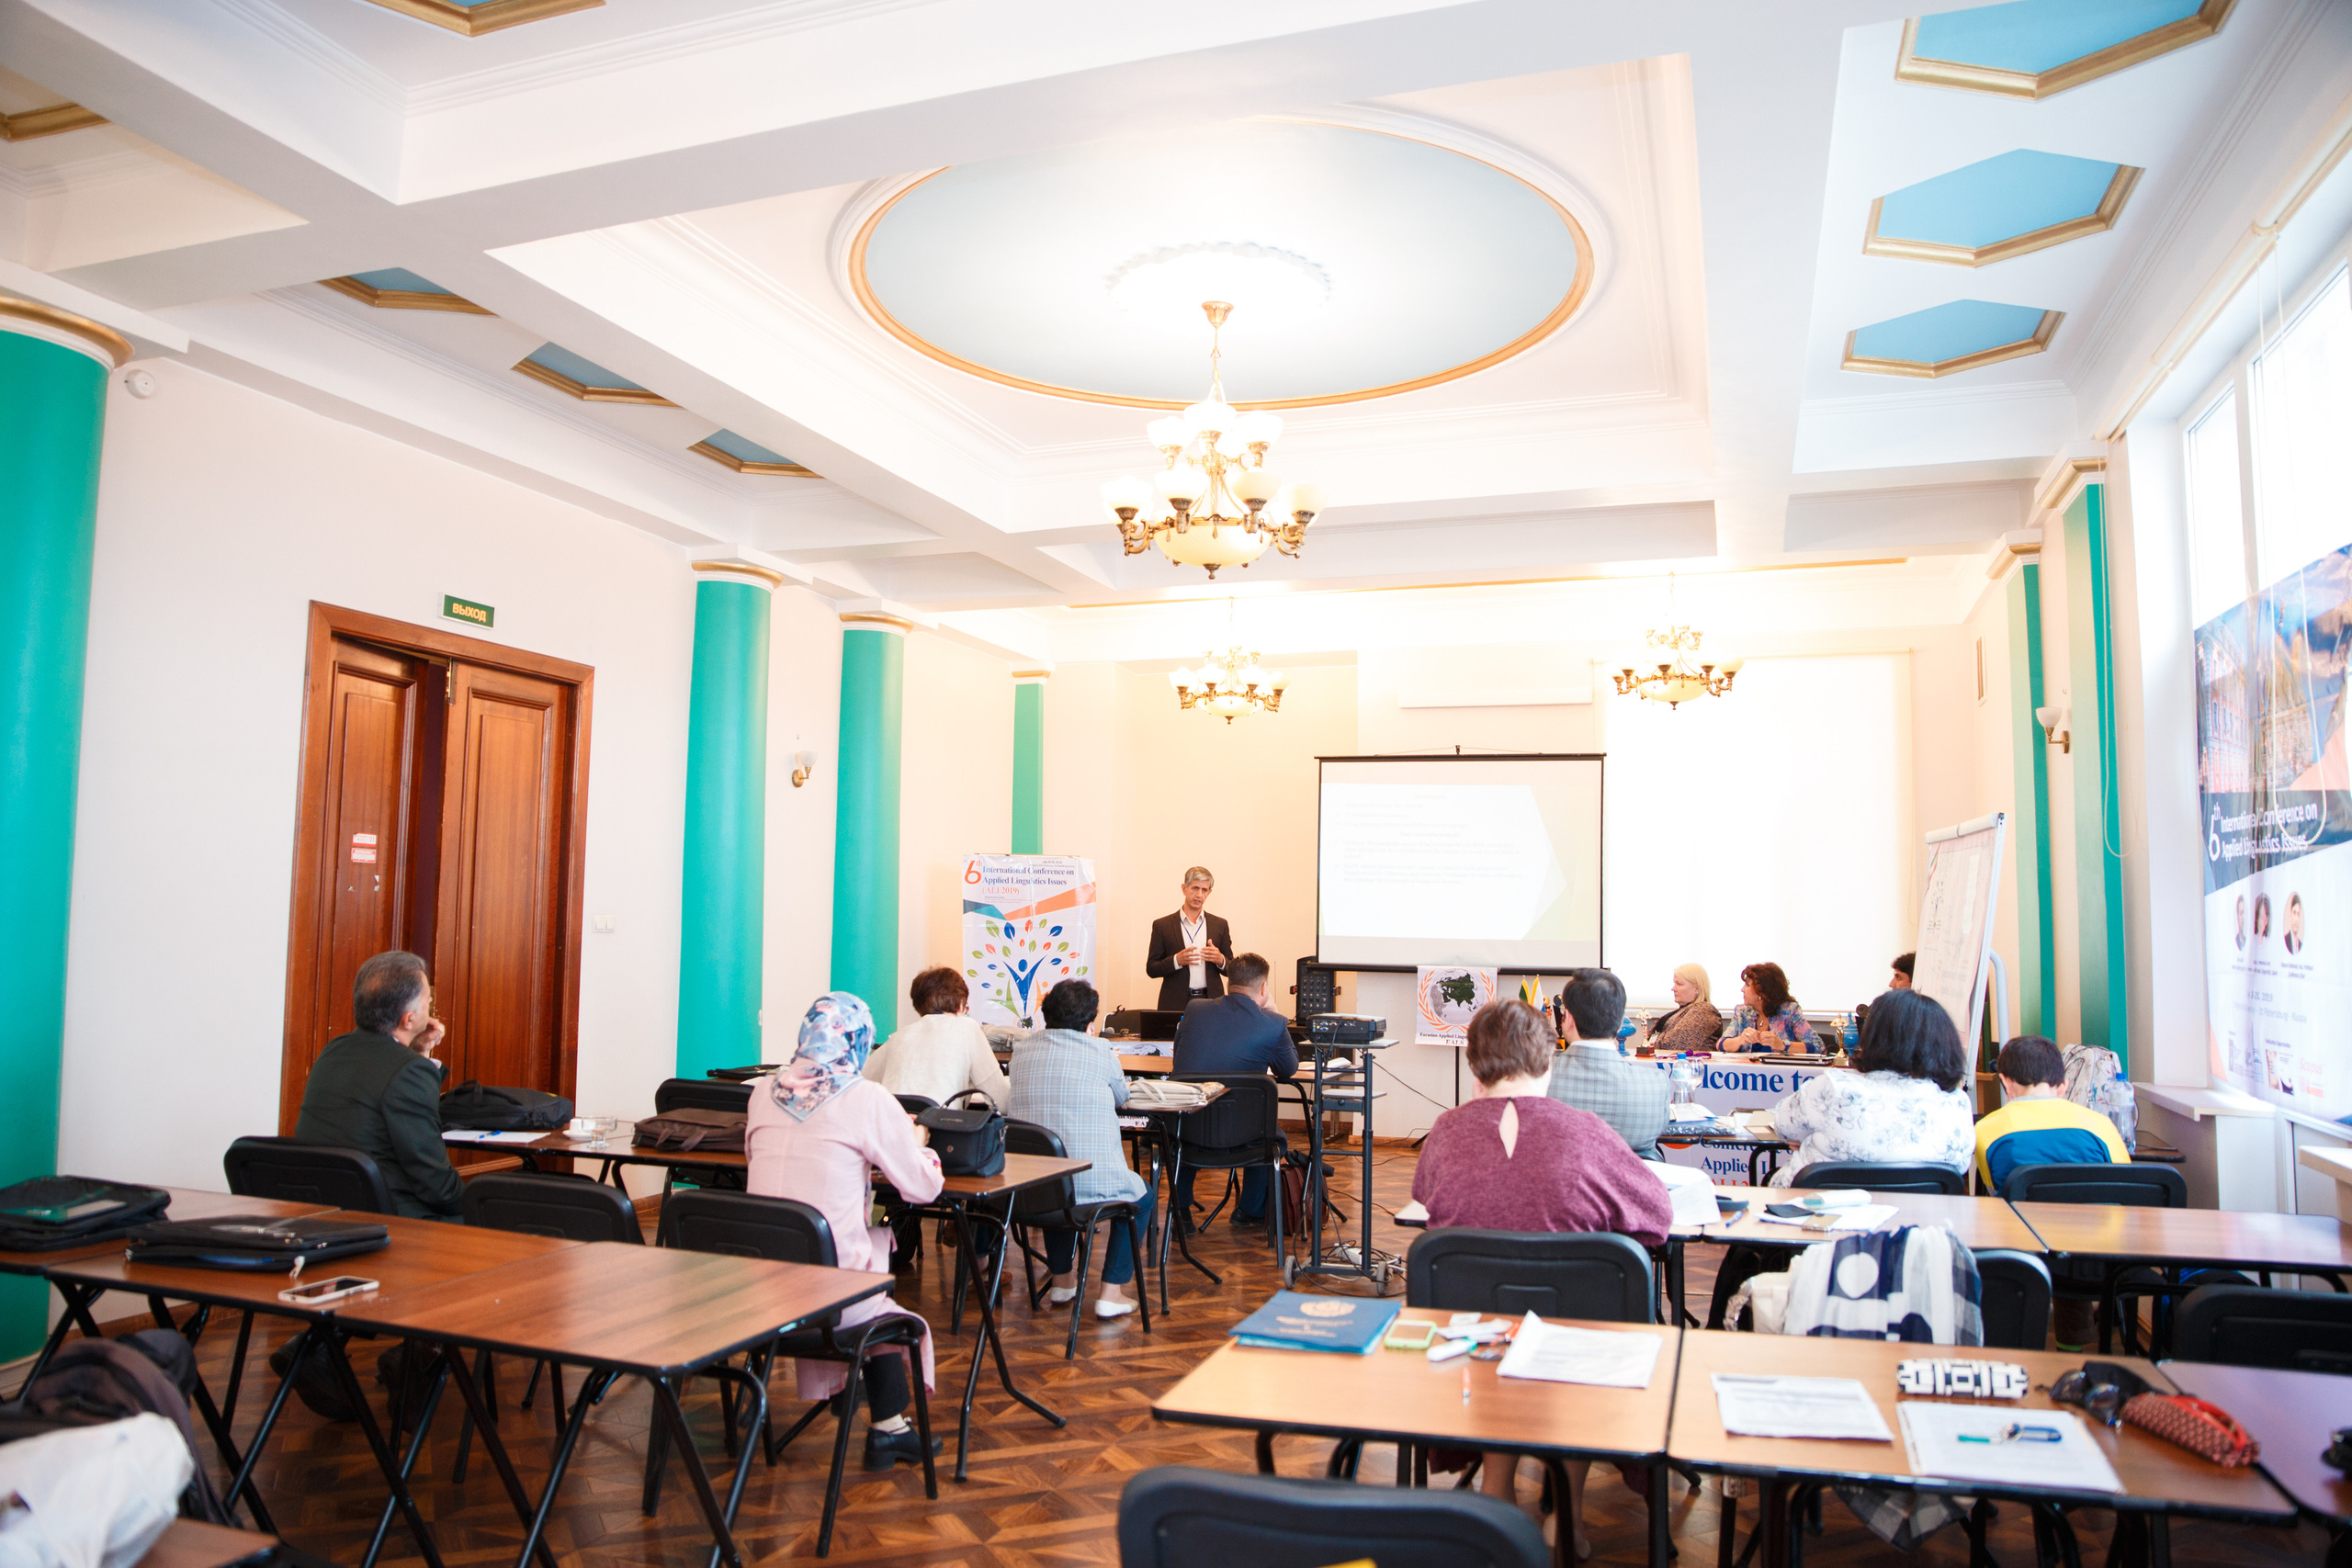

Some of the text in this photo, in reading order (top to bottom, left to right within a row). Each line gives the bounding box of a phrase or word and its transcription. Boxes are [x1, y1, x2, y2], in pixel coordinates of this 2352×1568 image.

[452, 603, 487, 623] ВЫХОД
[2305, 803, 2318, 821] on
[982, 865, 1026, 874] International
[1027, 867, 1066, 875] Conference
[982, 876, 1010, 886] Applied
[1011, 876, 1046, 886] Linguistics
[1001, 886, 1020, 896] 2019)
[1701, 1156, 1749, 1176] Applie
